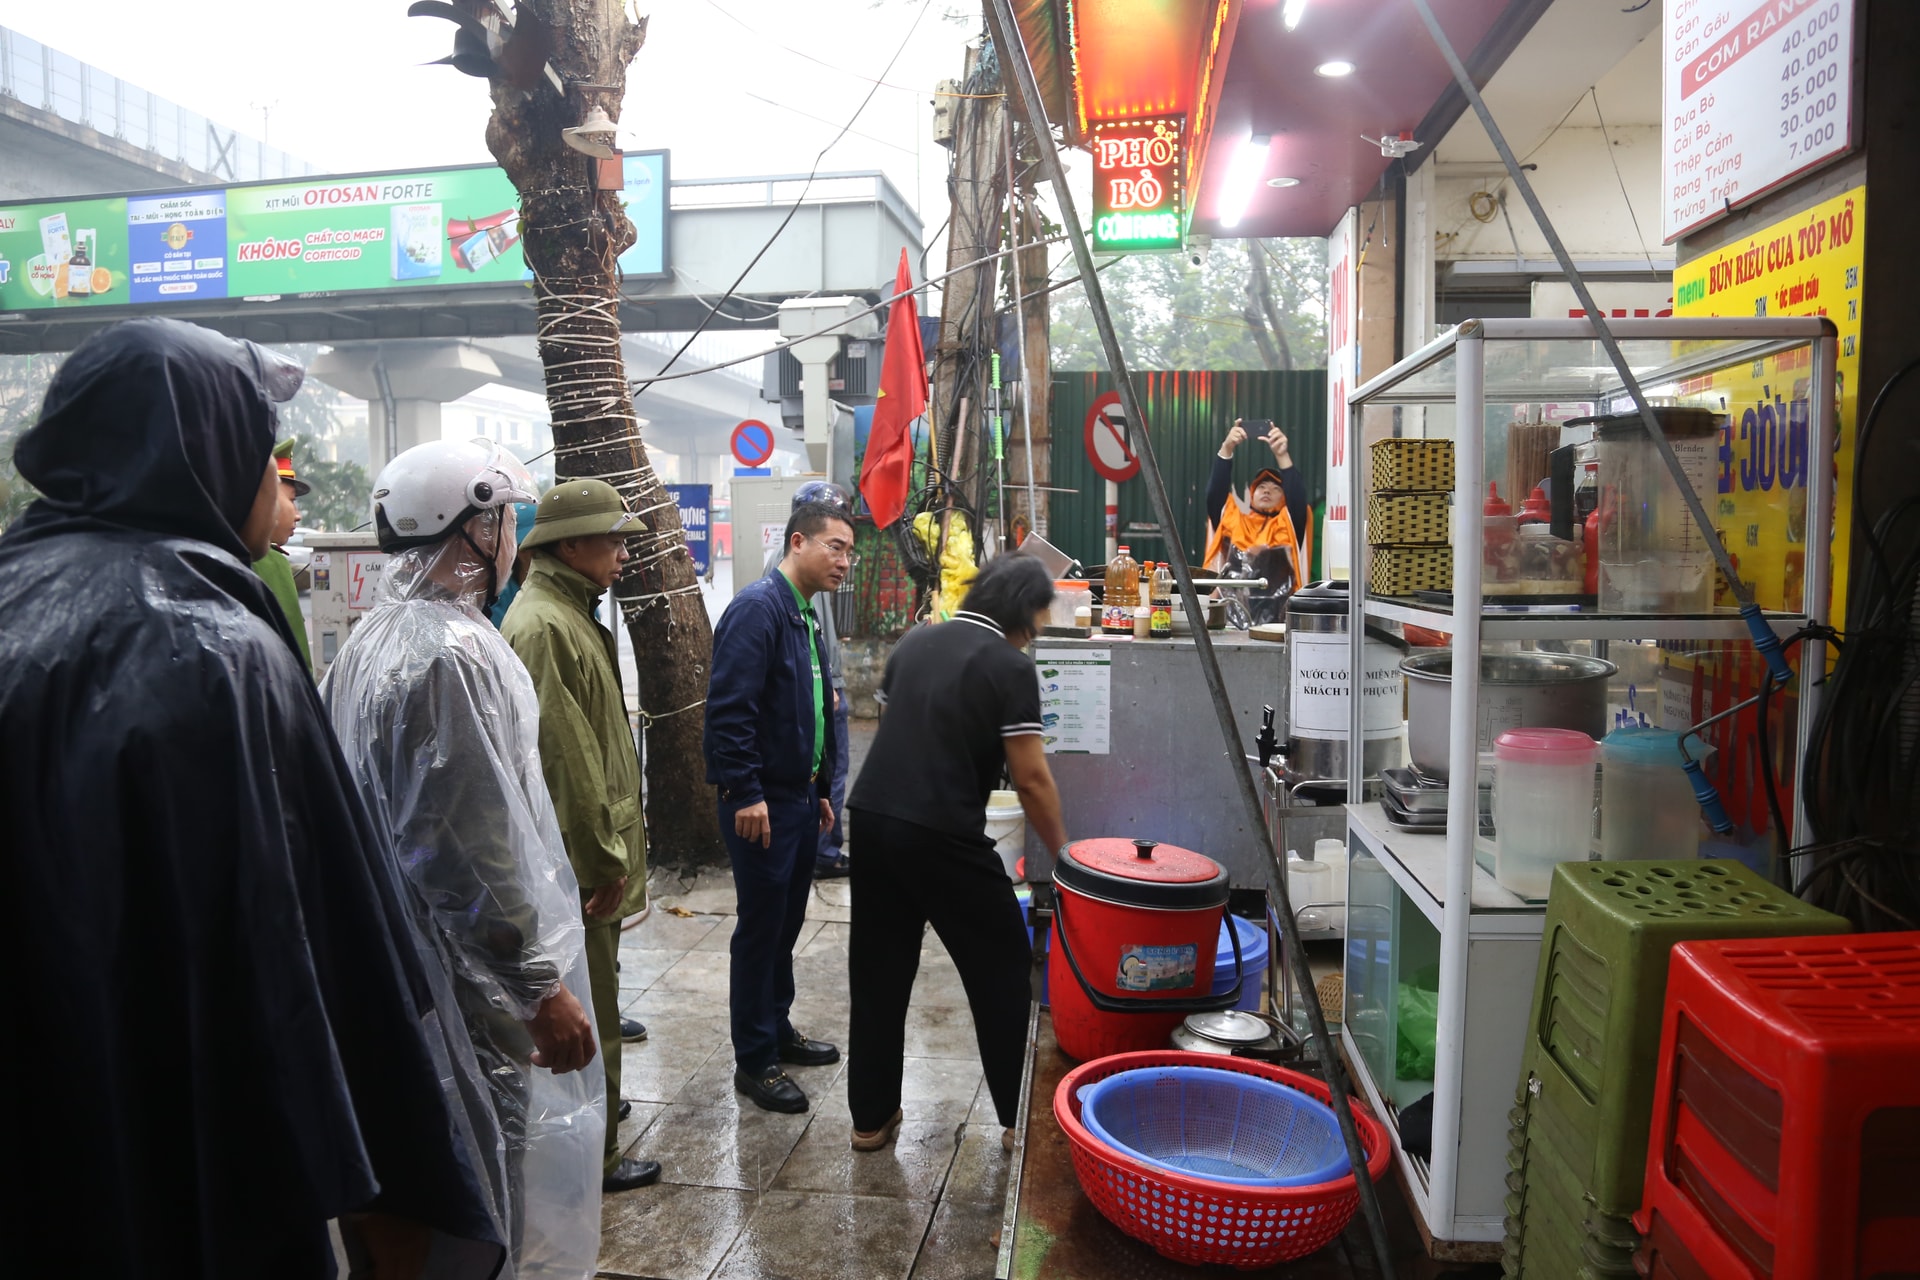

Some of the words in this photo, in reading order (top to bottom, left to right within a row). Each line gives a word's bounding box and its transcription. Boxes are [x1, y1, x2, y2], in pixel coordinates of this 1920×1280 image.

[1675, 38, 1699, 62] Gân
[1695, 37, 1740, 82] CƠM
[1674, 108, 1696, 131] Dưa
[1700, 94, 1715, 114] Bò
[1781, 2, 1840, 54] 40.000
[1696, 123, 1710, 141] Bò
[1781, 32, 1839, 82] 40.000
[1674, 153, 1702, 177] Thập
[1780, 62, 1838, 111] 35.000
[1099, 125, 1174, 169] PHỞ
[1674, 174, 1701, 201] Rang
[1705, 152, 1742, 182] Trứng
[1780, 92, 1837, 138] 30.000
[1674, 196, 1706, 224] Trứng
[1789, 122, 1834, 160] 7.000
[266, 198, 280, 210] XỊT
[282, 194, 300, 208] MŨI
[304, 185, 378, 206] OTOSAN
[382, 183, 433, 200] FORTE
[1110, 169, 1162, 208] BÒ
[306, 228, 333, 244] CHẤT
[335, 232, 350, 242] CO
[354, 229, 384, 244] MẠCH
[238, 239, 301, 260] KHÔNG
[304, 249, 360, 261] CORTICOID
[1677, 276, 1706, 308] menu
[1709, 254, 1732, 296] BÚN
[1736, 241, 1764, 286] RIÊU
[1768, 236, 1794, 273] CUA
[1798, 214, 1826, 261] TÓP
[1829, 198, 1854, 250] MỠ
[1845, 266, 1858, 290] 35K
[1848, 299, 1857, 321] 7K
[1843, 334, 1856, 357] 12K
[1675, 444, 1705, 453] Blender
[684, 530, 706, 541] TERIALS
[365, 562, 381, 572] CẤM
[1300, 669, 1328, 679] NƯỚC
[1331, 669, 1349, 680] UỐ
[1304, 684, 1341, 696] KHÁCH
[1363, 686, 1388, 697] PHỤC
[1390, 685, 1399, 696] VỤ
